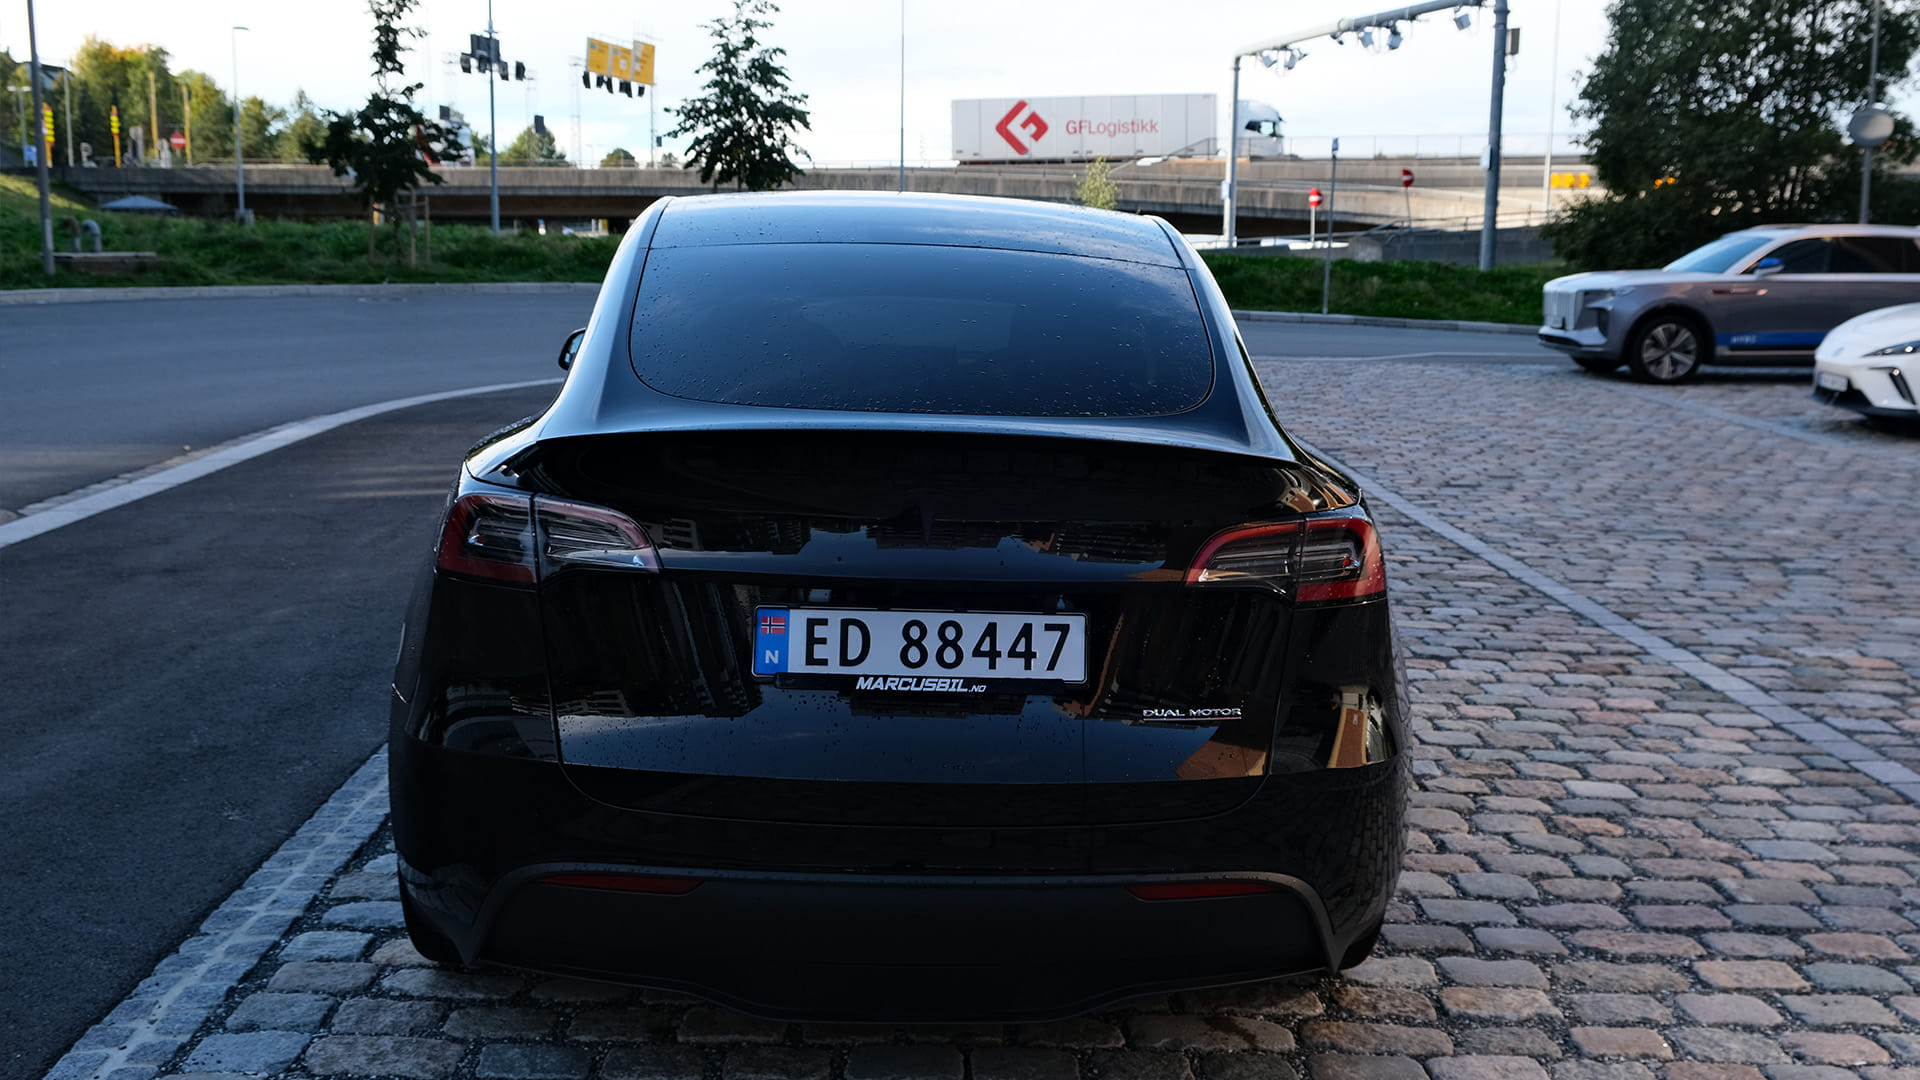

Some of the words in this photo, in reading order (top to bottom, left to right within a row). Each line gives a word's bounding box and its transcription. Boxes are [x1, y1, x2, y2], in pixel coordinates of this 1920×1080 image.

[1066, 119, 1159, 137] GFLogistikk
[805, 617, 871, 667] ED
[899, 619, 1071, 671] 88447
[765, 650, 779, 664] N
[1142, 709, 1185, 717] DUAL
[1189, 708, 1242, 717] MOTOR
